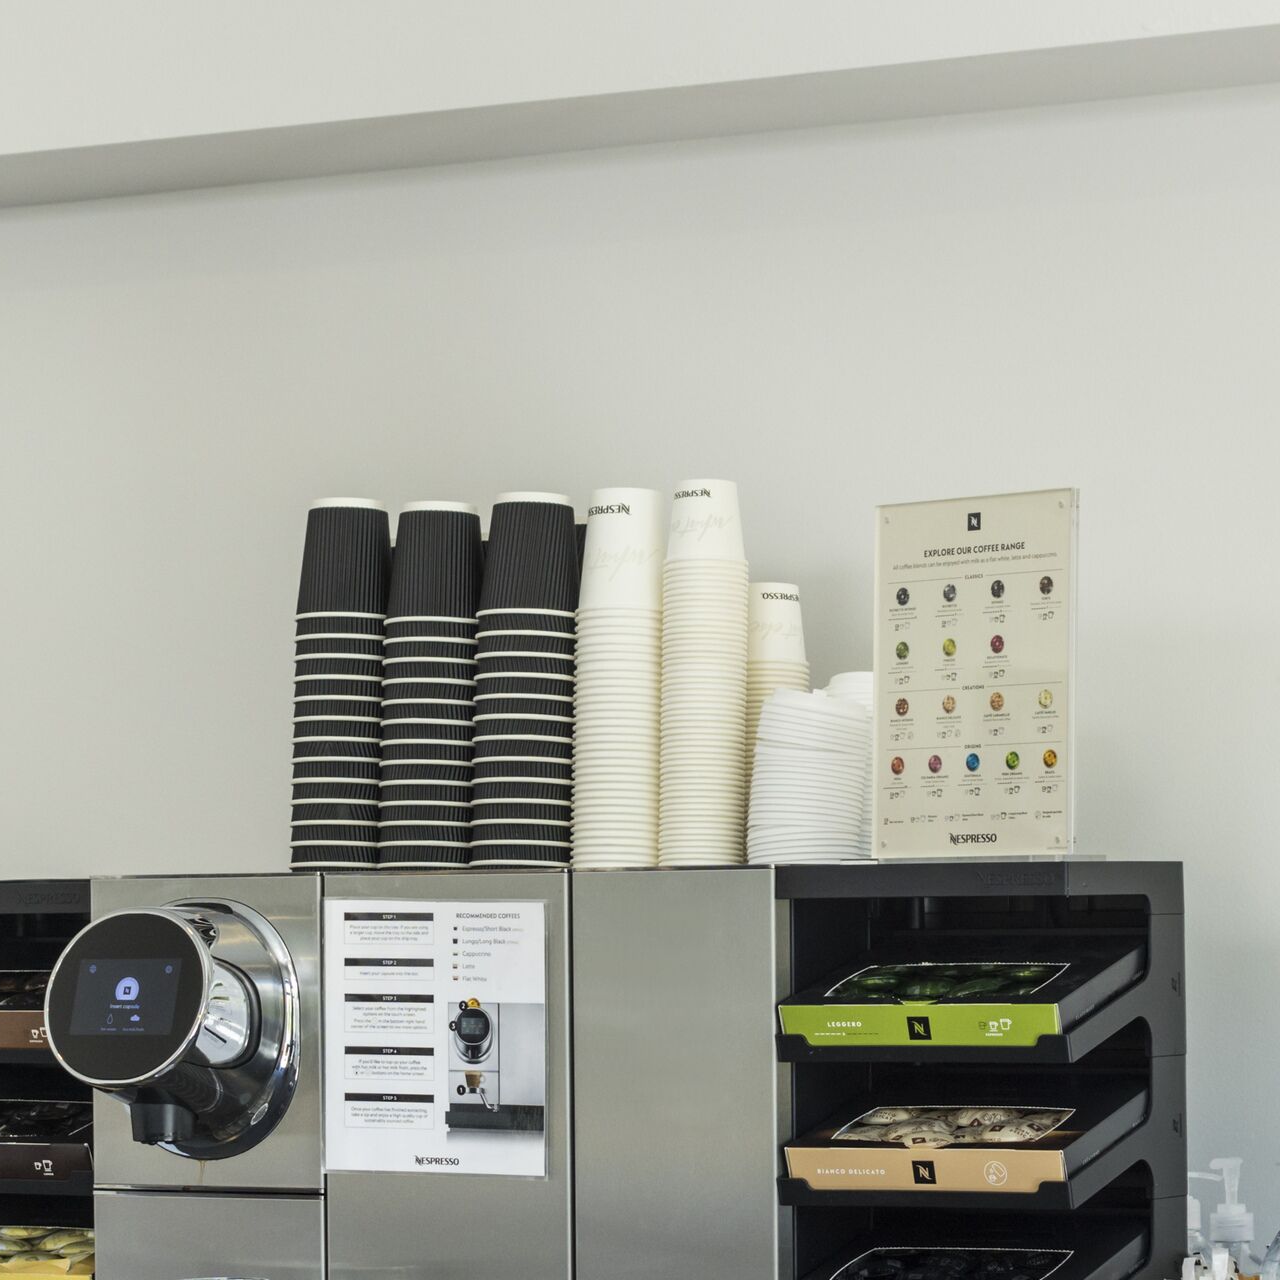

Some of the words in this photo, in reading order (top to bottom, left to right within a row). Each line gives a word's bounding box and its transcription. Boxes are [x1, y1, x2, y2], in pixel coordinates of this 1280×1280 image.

[674, 488, 711, 500] NESPRESS
[588, 502, 632, 517] NESPRESS
[924, 548, 955, 558] EXPLORE
[956, 546, 972, 555] OUR
[973, 543, 999, 554] COFFEE
[1000, 542, 1025, 551] RANGE
[761, 592, 800, 601] ESPRESSO
[949, 833, 998, 845] NESPRESSO
[413, 1155, 460, 1166] NESPRESSO
